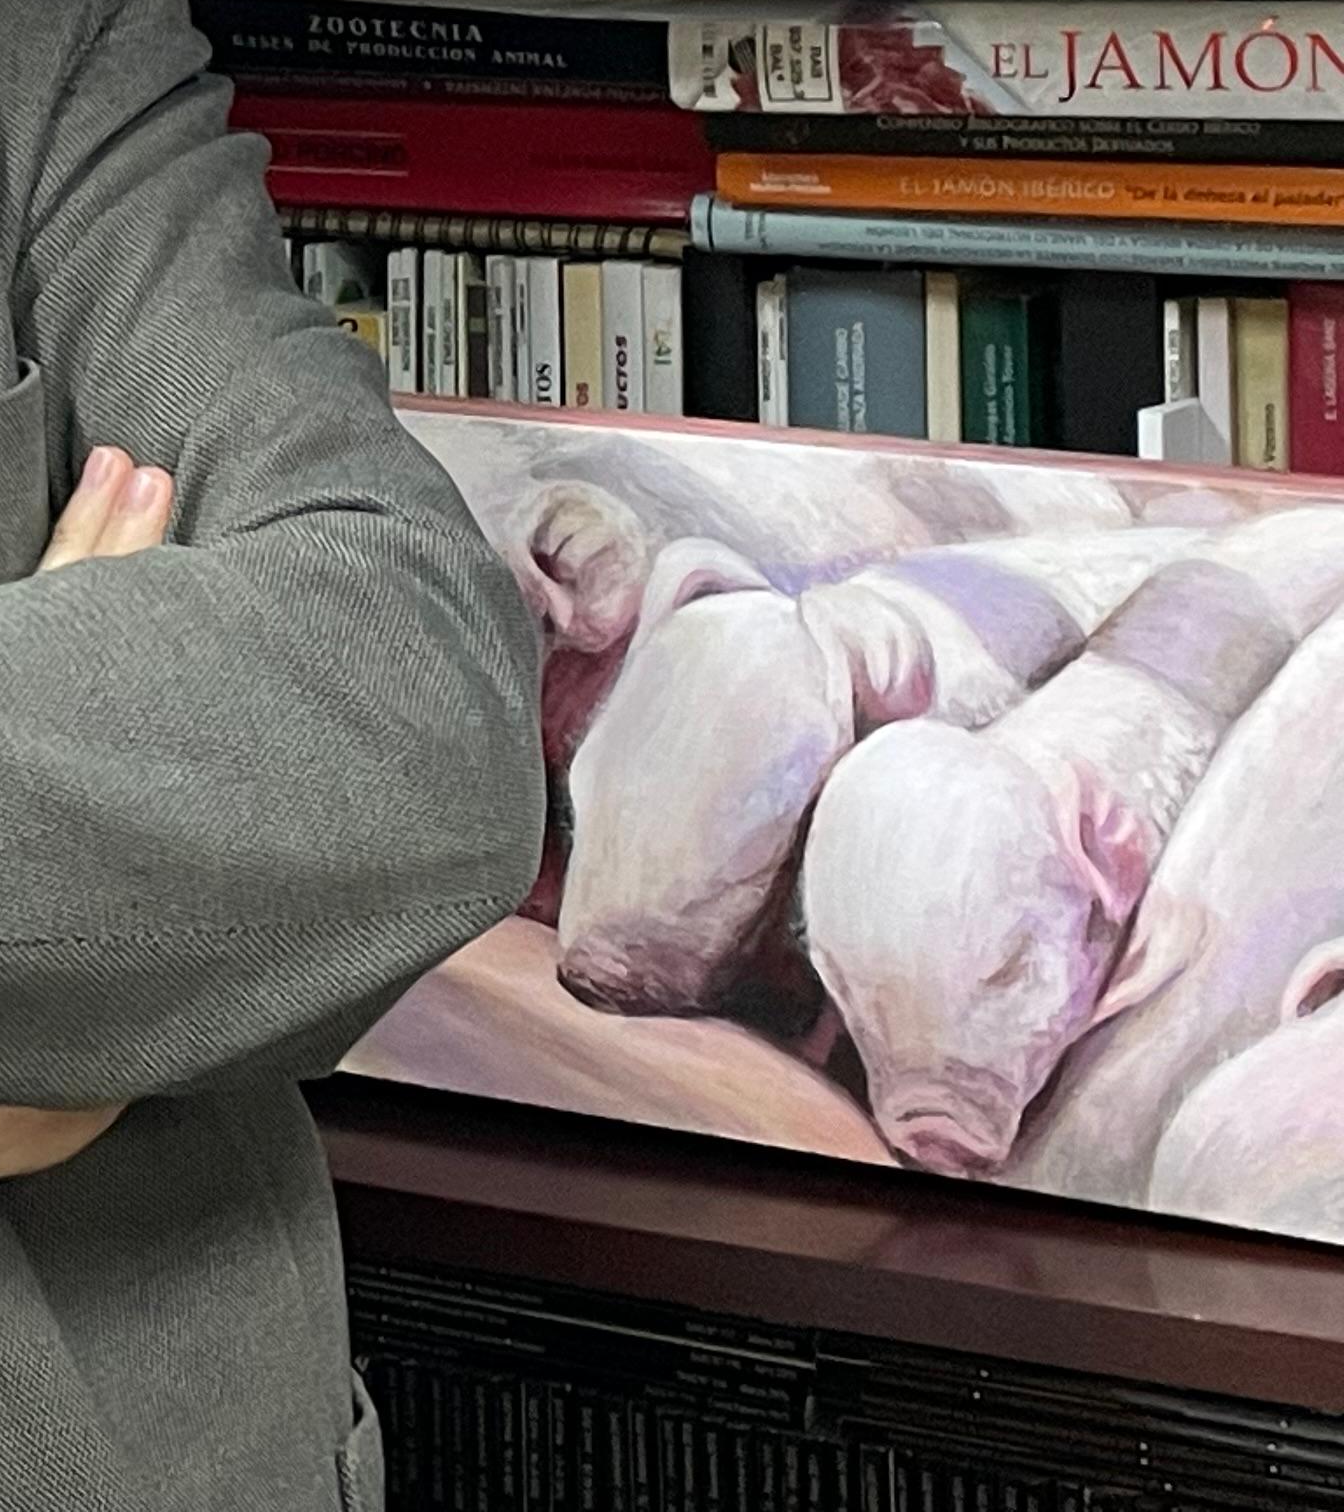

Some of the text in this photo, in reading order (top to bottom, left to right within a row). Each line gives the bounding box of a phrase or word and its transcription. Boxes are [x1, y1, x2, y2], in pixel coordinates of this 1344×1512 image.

[306, 13, 485, 44] ZOOTECNIA
[231, 33, 295, 53] BASES
[307, 38, 334, 56] DE
[490, 49, 570, 70] ANIMAL
[991, 42, 1048, 81] EL
[874, 114, 1197, 135] COMPENDIO SOBRE EL CERDO
[959, 134, 1175, 154] Y SUS PRODUCTOS DERIVADOS
[899, 173, 1270, 205] EL JAMÓN IBÉRICO la dehesa al
